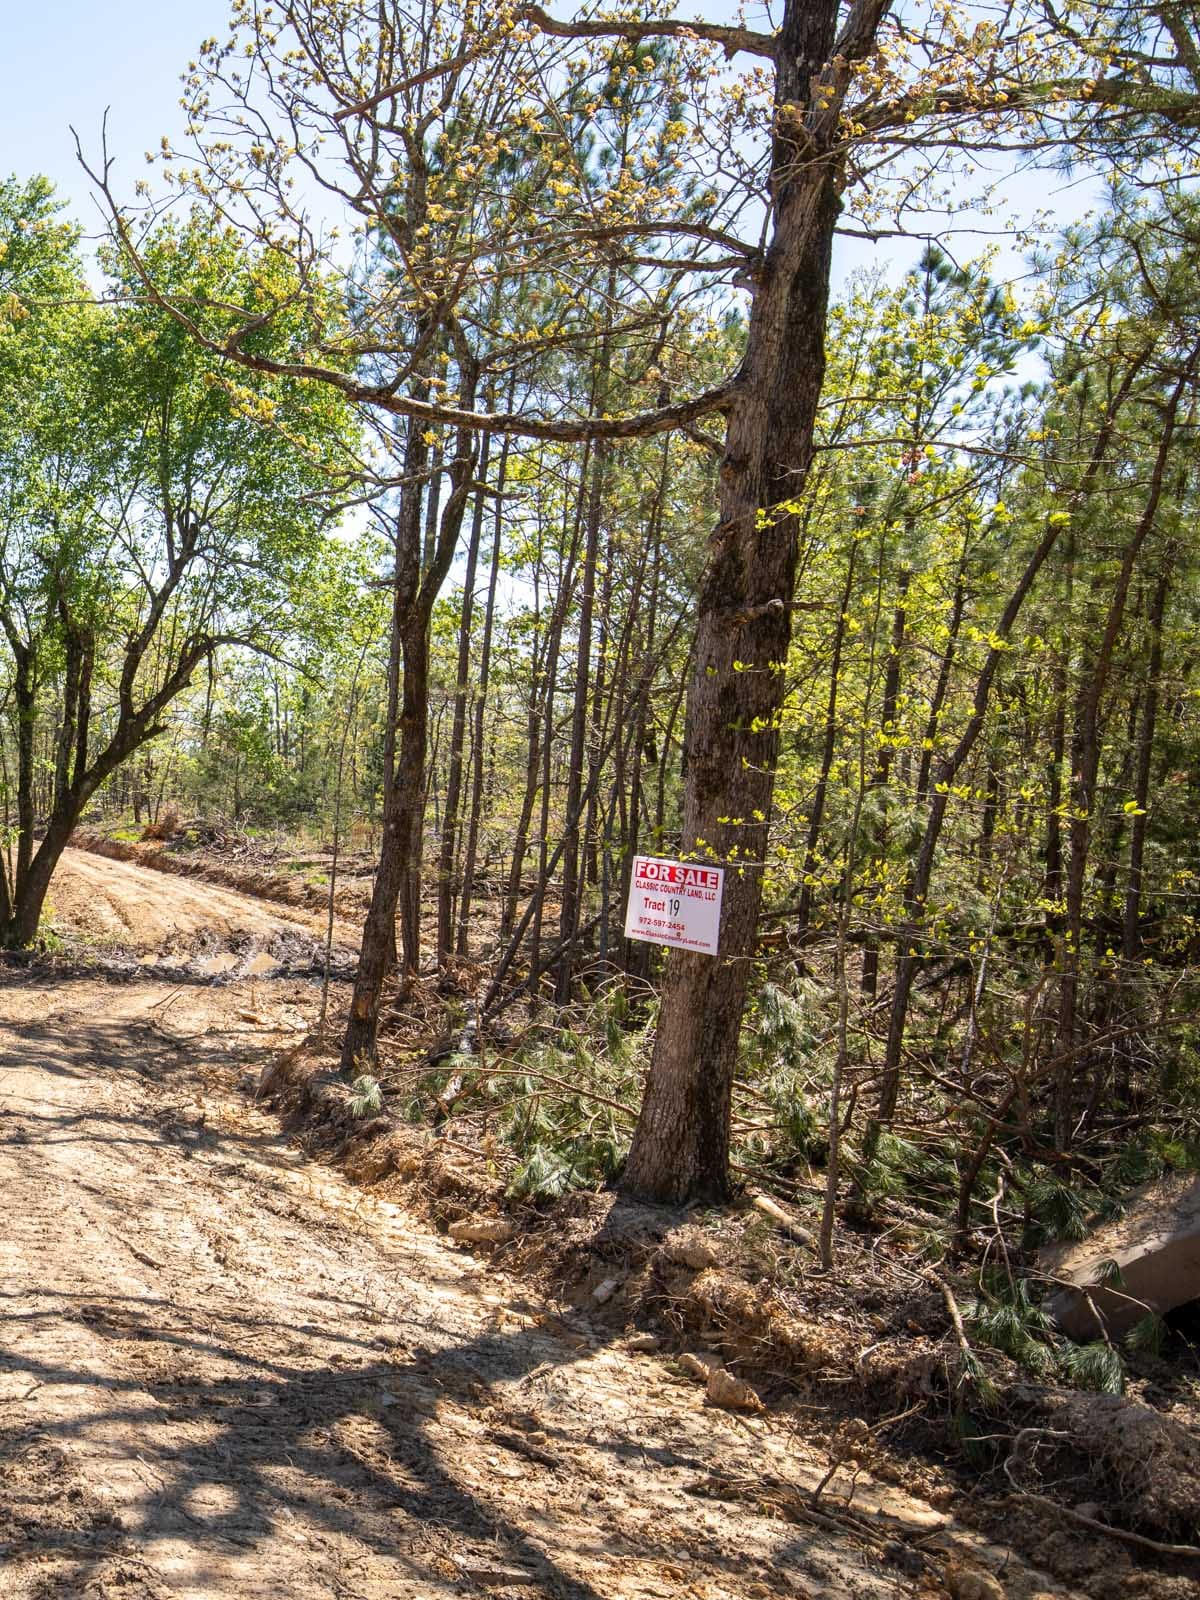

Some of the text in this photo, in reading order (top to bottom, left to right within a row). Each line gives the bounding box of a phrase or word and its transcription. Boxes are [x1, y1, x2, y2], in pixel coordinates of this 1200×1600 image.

[636, 862, 719, 889] FOR SALE
[635, 880, 716, 901] CLASSIC COUNTRY LAND, LLC
[644, 897, 680, 917] Tract 19
